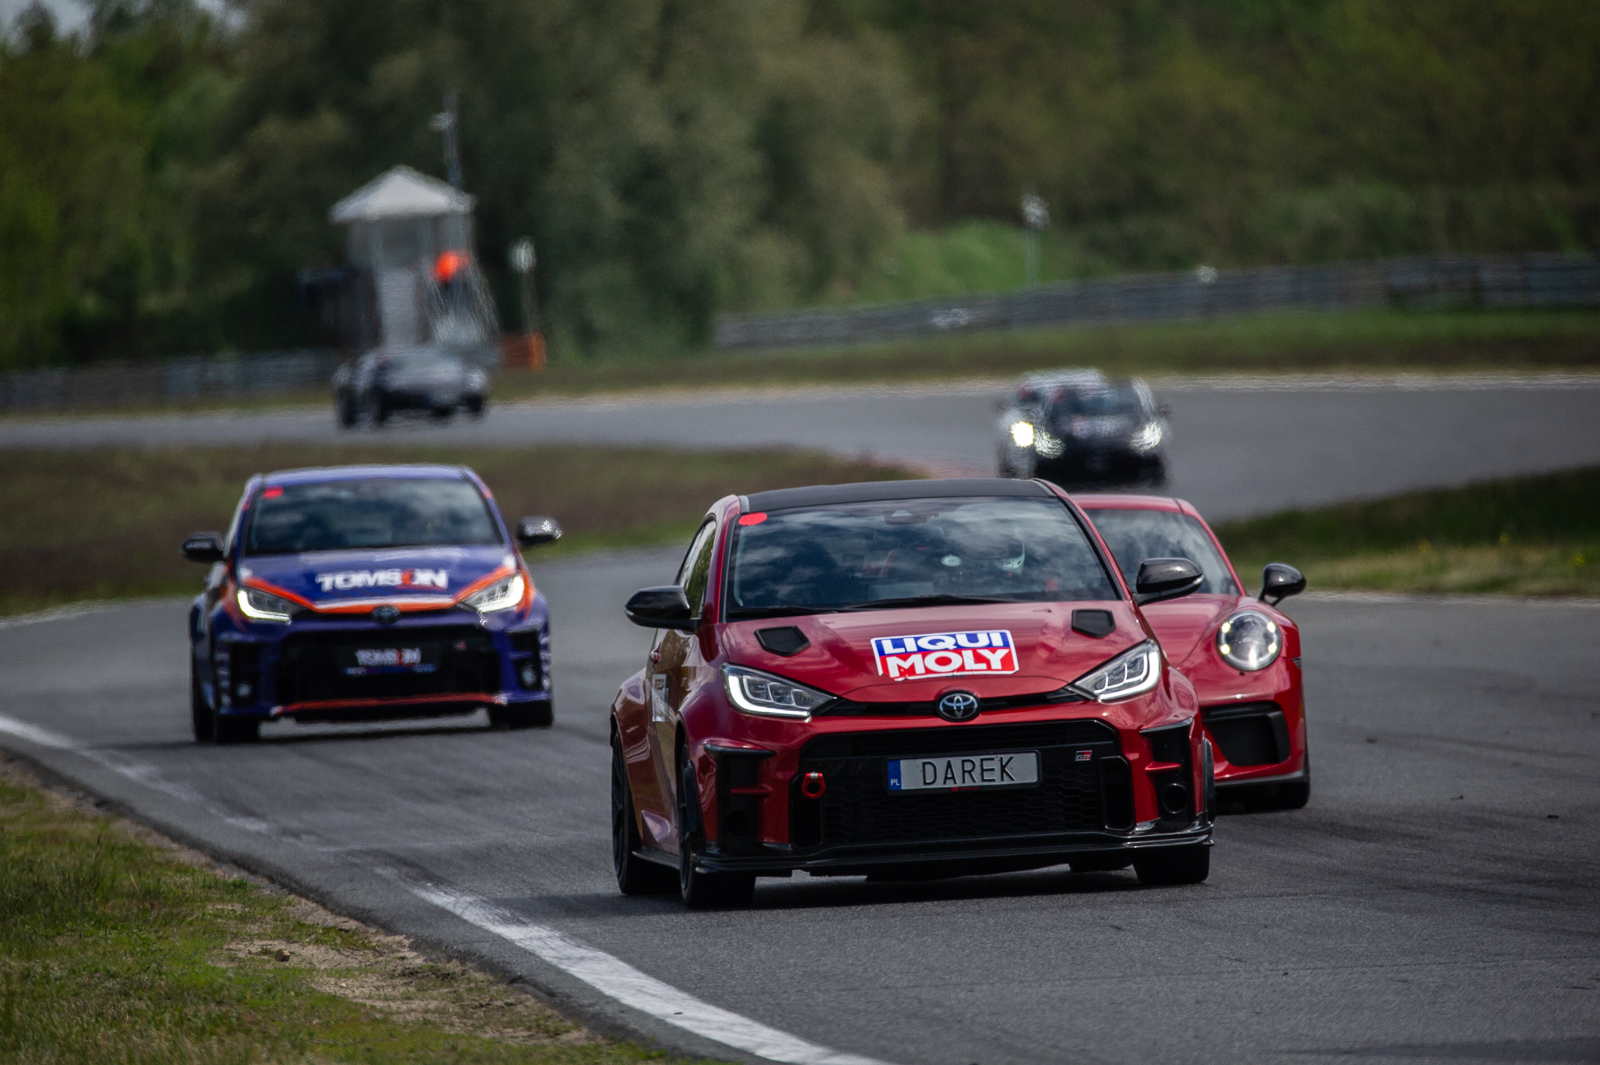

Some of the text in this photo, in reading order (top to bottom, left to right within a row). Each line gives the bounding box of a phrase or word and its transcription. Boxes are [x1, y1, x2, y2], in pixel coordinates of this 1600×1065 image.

[315, 569, 449, 592] TOMSON
[882, 632, 1004, 654] LIQUI
[886, 649, 1010, 677] MOLY
[890, 778, 900, 786] PL
[922, 756, 1016, 786] DAREK
